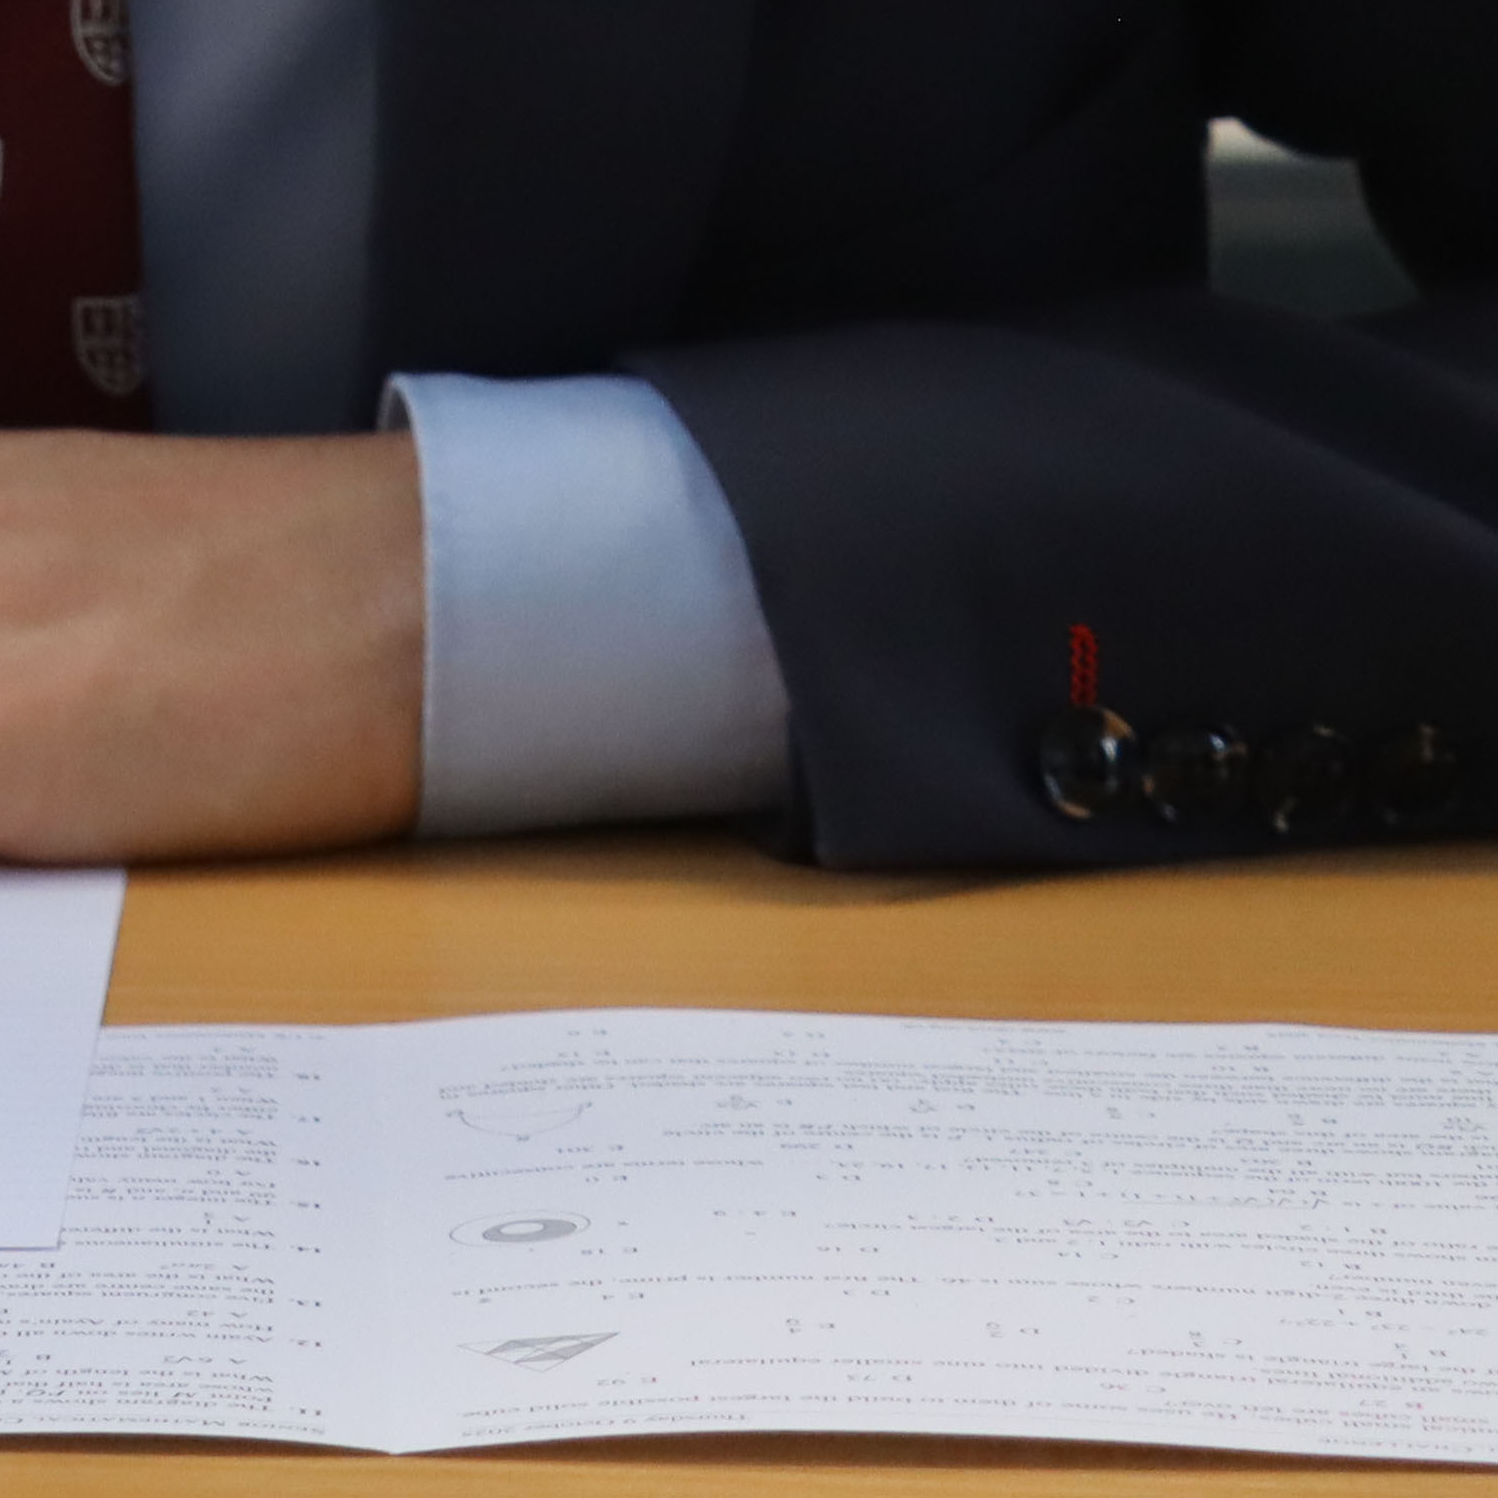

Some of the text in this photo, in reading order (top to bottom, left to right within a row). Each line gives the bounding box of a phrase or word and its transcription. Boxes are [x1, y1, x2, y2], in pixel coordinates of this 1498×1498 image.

[74, 1239, 224, 1248] simultaneous
[15, 1272, 51, 1280] the
[59, 1272, 82, 1280] of
[89, 1271, 137, 1279] area
[145, 1272, 180, 1281] the
[187, 1273, 206, 1281] is
[214, 1274, 276, 1286] What
[725, 1274, 814, 1283] number
[823, 1275, 868, 1283] first
[877, 1275, 921, 1284] The
[568, 1278, 604, 1288] the
[1007, 1278, 1057, 1286] sum
[1065, 1281, 1142, 1290] whose
[173, 1284, 232, 1292] same
[239, 1287, 275, 1296] the
[478, 1281, 560, 1296] second
[101, 1290, 218, 1300] congruent
[225, 1294, 275, 1305] Five
[146, 1319, 210, 1328] many
[219, 1322, 274, 1333] How
[16, 1329, 45, 1338] all
[52, 1329, 118, 1338] down
[125, 1330, 197, 1339] writes
[1264, 1355, 1360, 1368] triangle
[55, 1367, 129, 1377] length
[138, 1369, 175, 1378] the
[690, 1356, 1402, 1391] equilateral triangle divided into nine smaller equilateral
[211, 1371, 274, 1384] What
[4, 1380, 50, 1389] that
[57, 1380, 103, 1389] half
[139, 1381, 190, 1389] area
[198, 1383, 274, 1394] whose
[117, 1390, 160, 1399] lies
[210, 1392, 273, 1404] Point
[710, 1393, 791, 1403] largest
[799, 1394, 838, 1403] the
[33, 1398, 107, 1407] shows
[116, 1397, 218, 1409] diagram
[598, 1394, 700, 1407] possible
[846, 1395, 912, 1405] build
[953, 1398, 1017, 1408] them
[1026, 1400, 1053, 1409] of
[227, 1402, 274, 1412] The
[528, 1401, 588, 1414] solid
[1061, 1402, 1128, 1412] some
[1137, 1406, 1192, 1416] uses
[645, 1413, 746, 1423] Thursday
[1202, 1410, 1238, 1421] He
[38, 1416, 226, 1428] MATHEMATICAL
[525, 1418, 616, 1431] October
[1342, 1420, 1411, 1430] small
